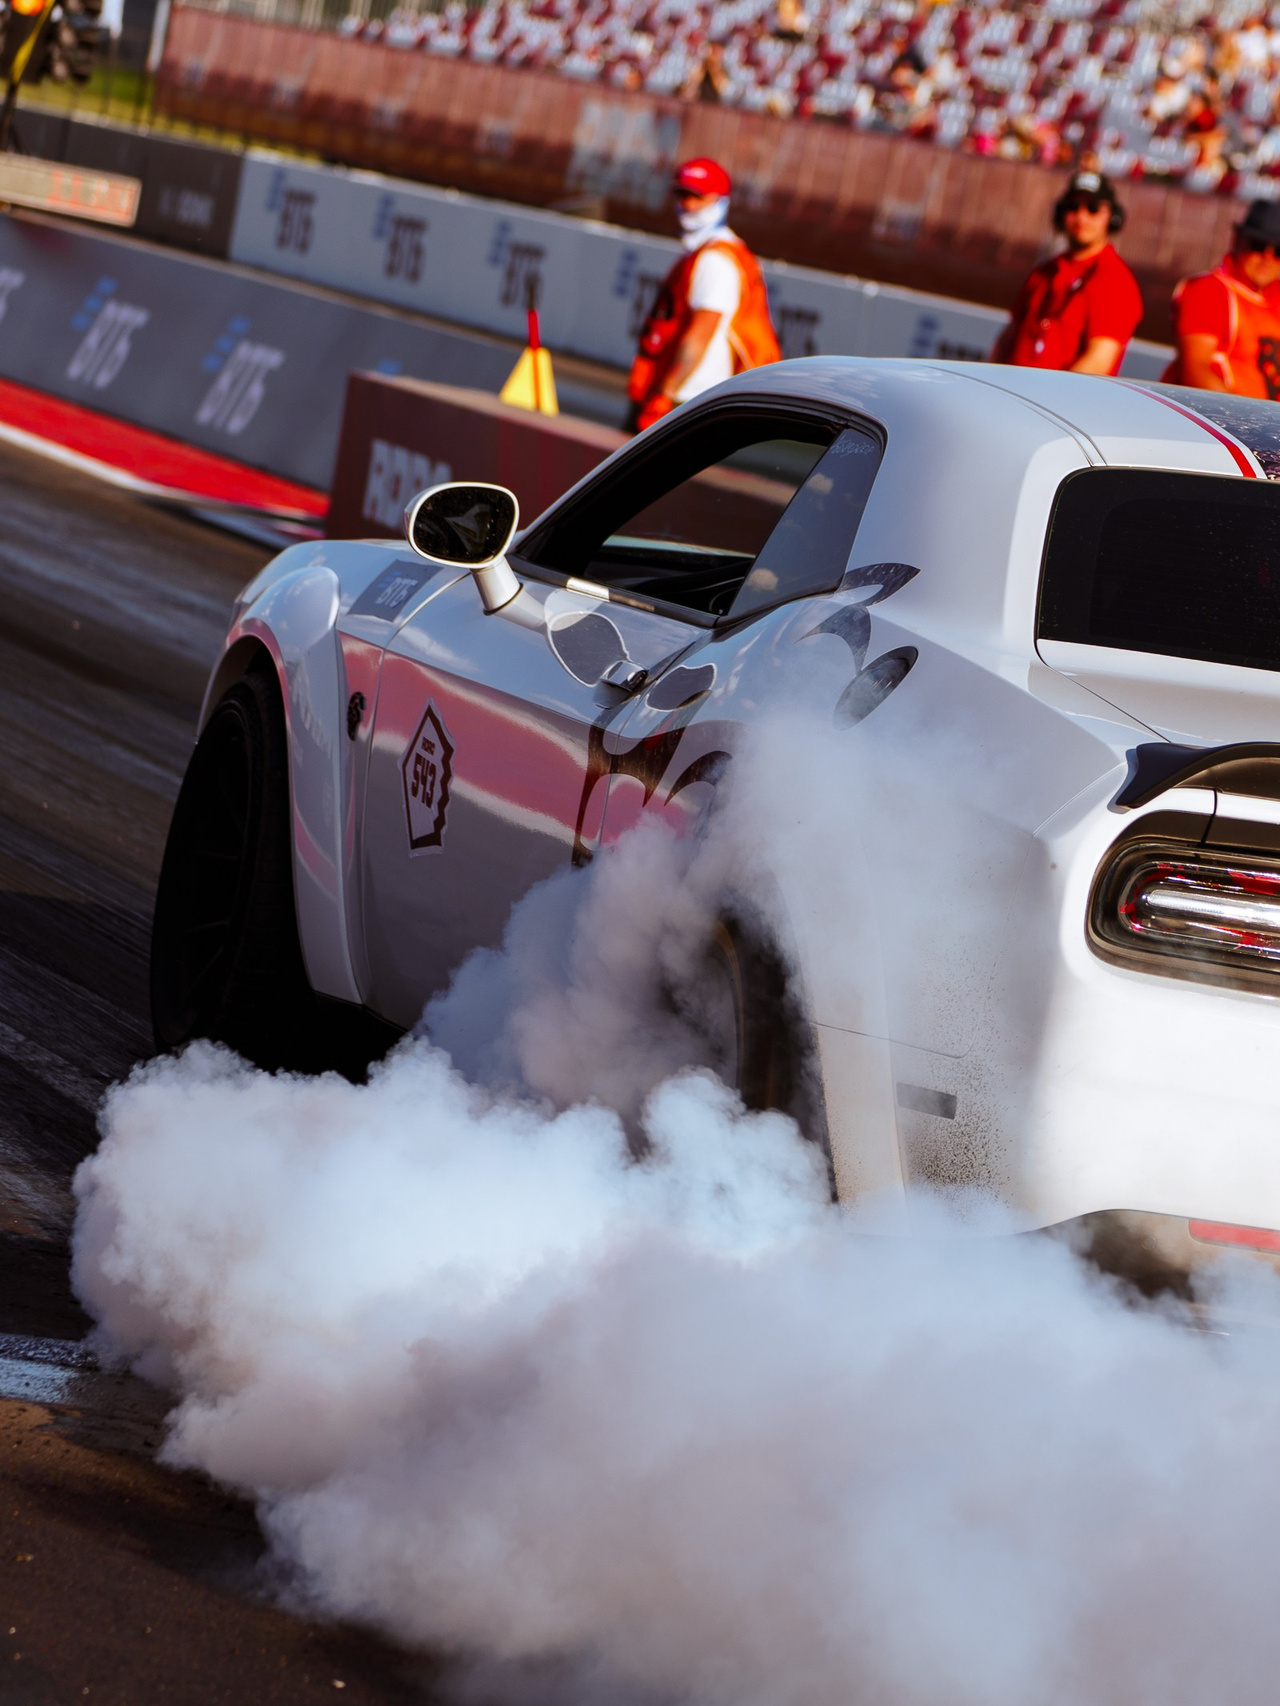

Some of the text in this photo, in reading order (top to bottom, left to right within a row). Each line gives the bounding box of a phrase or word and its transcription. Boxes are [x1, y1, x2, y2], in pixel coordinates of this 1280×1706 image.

[362, 437, 453, 534] RDR
[375, 576, 419, 608] ВТБ
[411, 752, 437, 809] 543
